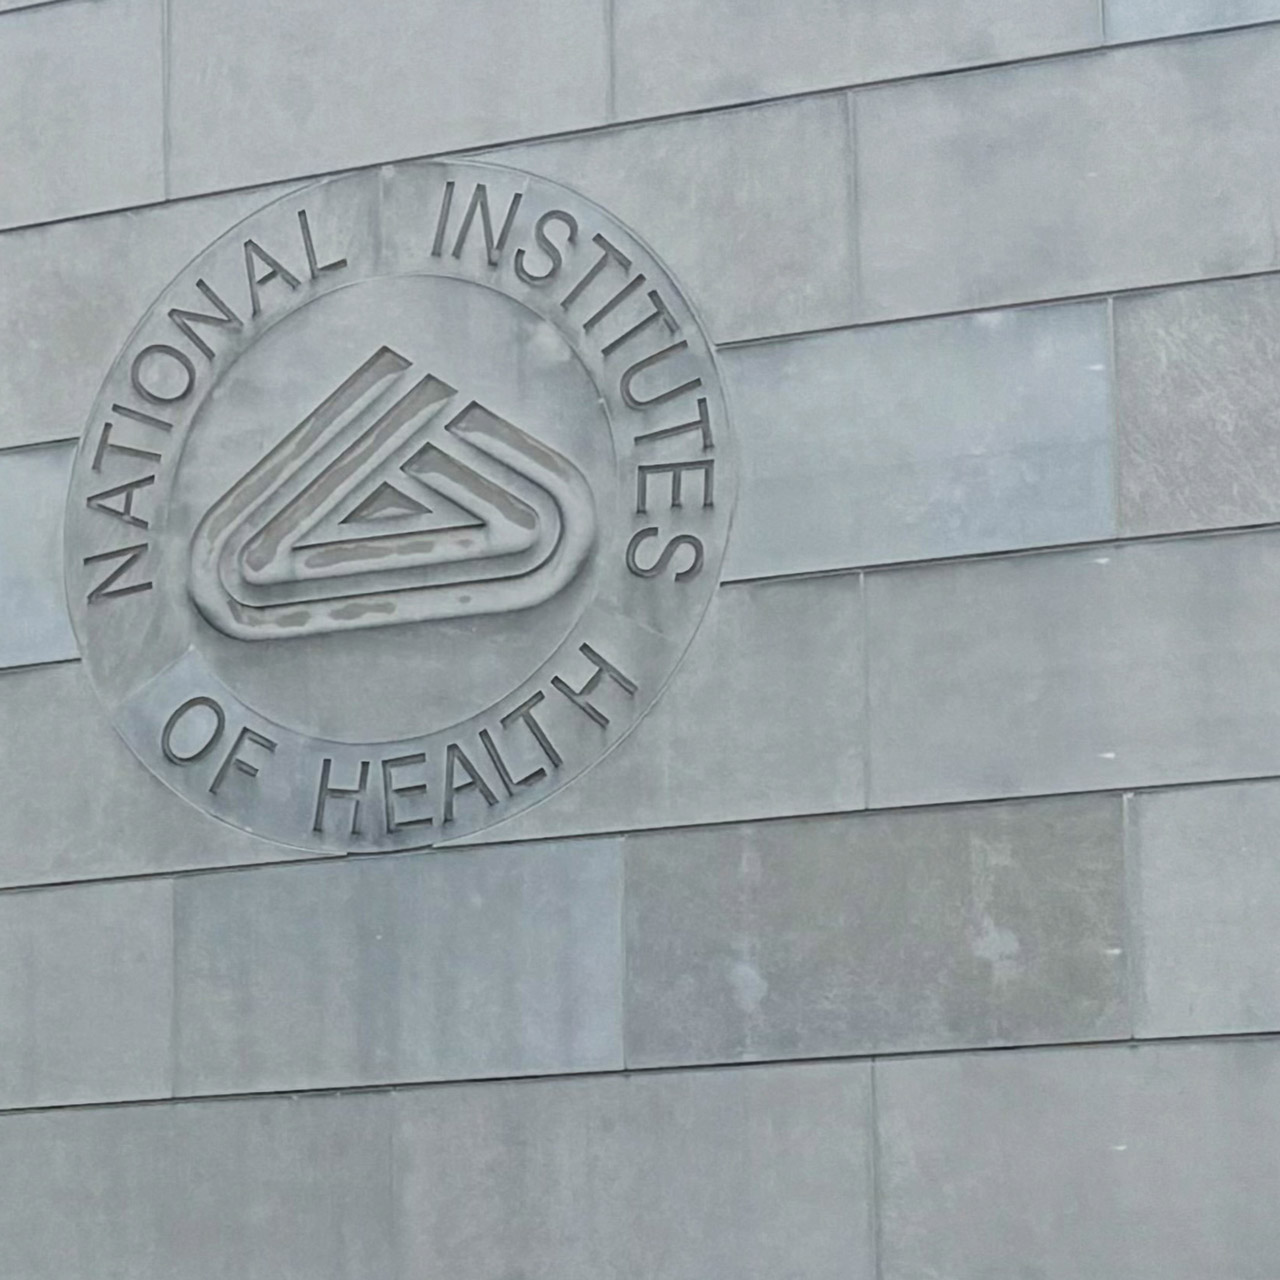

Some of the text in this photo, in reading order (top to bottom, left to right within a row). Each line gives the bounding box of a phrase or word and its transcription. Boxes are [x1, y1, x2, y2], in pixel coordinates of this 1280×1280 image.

[84, 180, 716, 606] NATIONAL INSTITUTES
[161, 642, 638, 835] OF HEALTH
